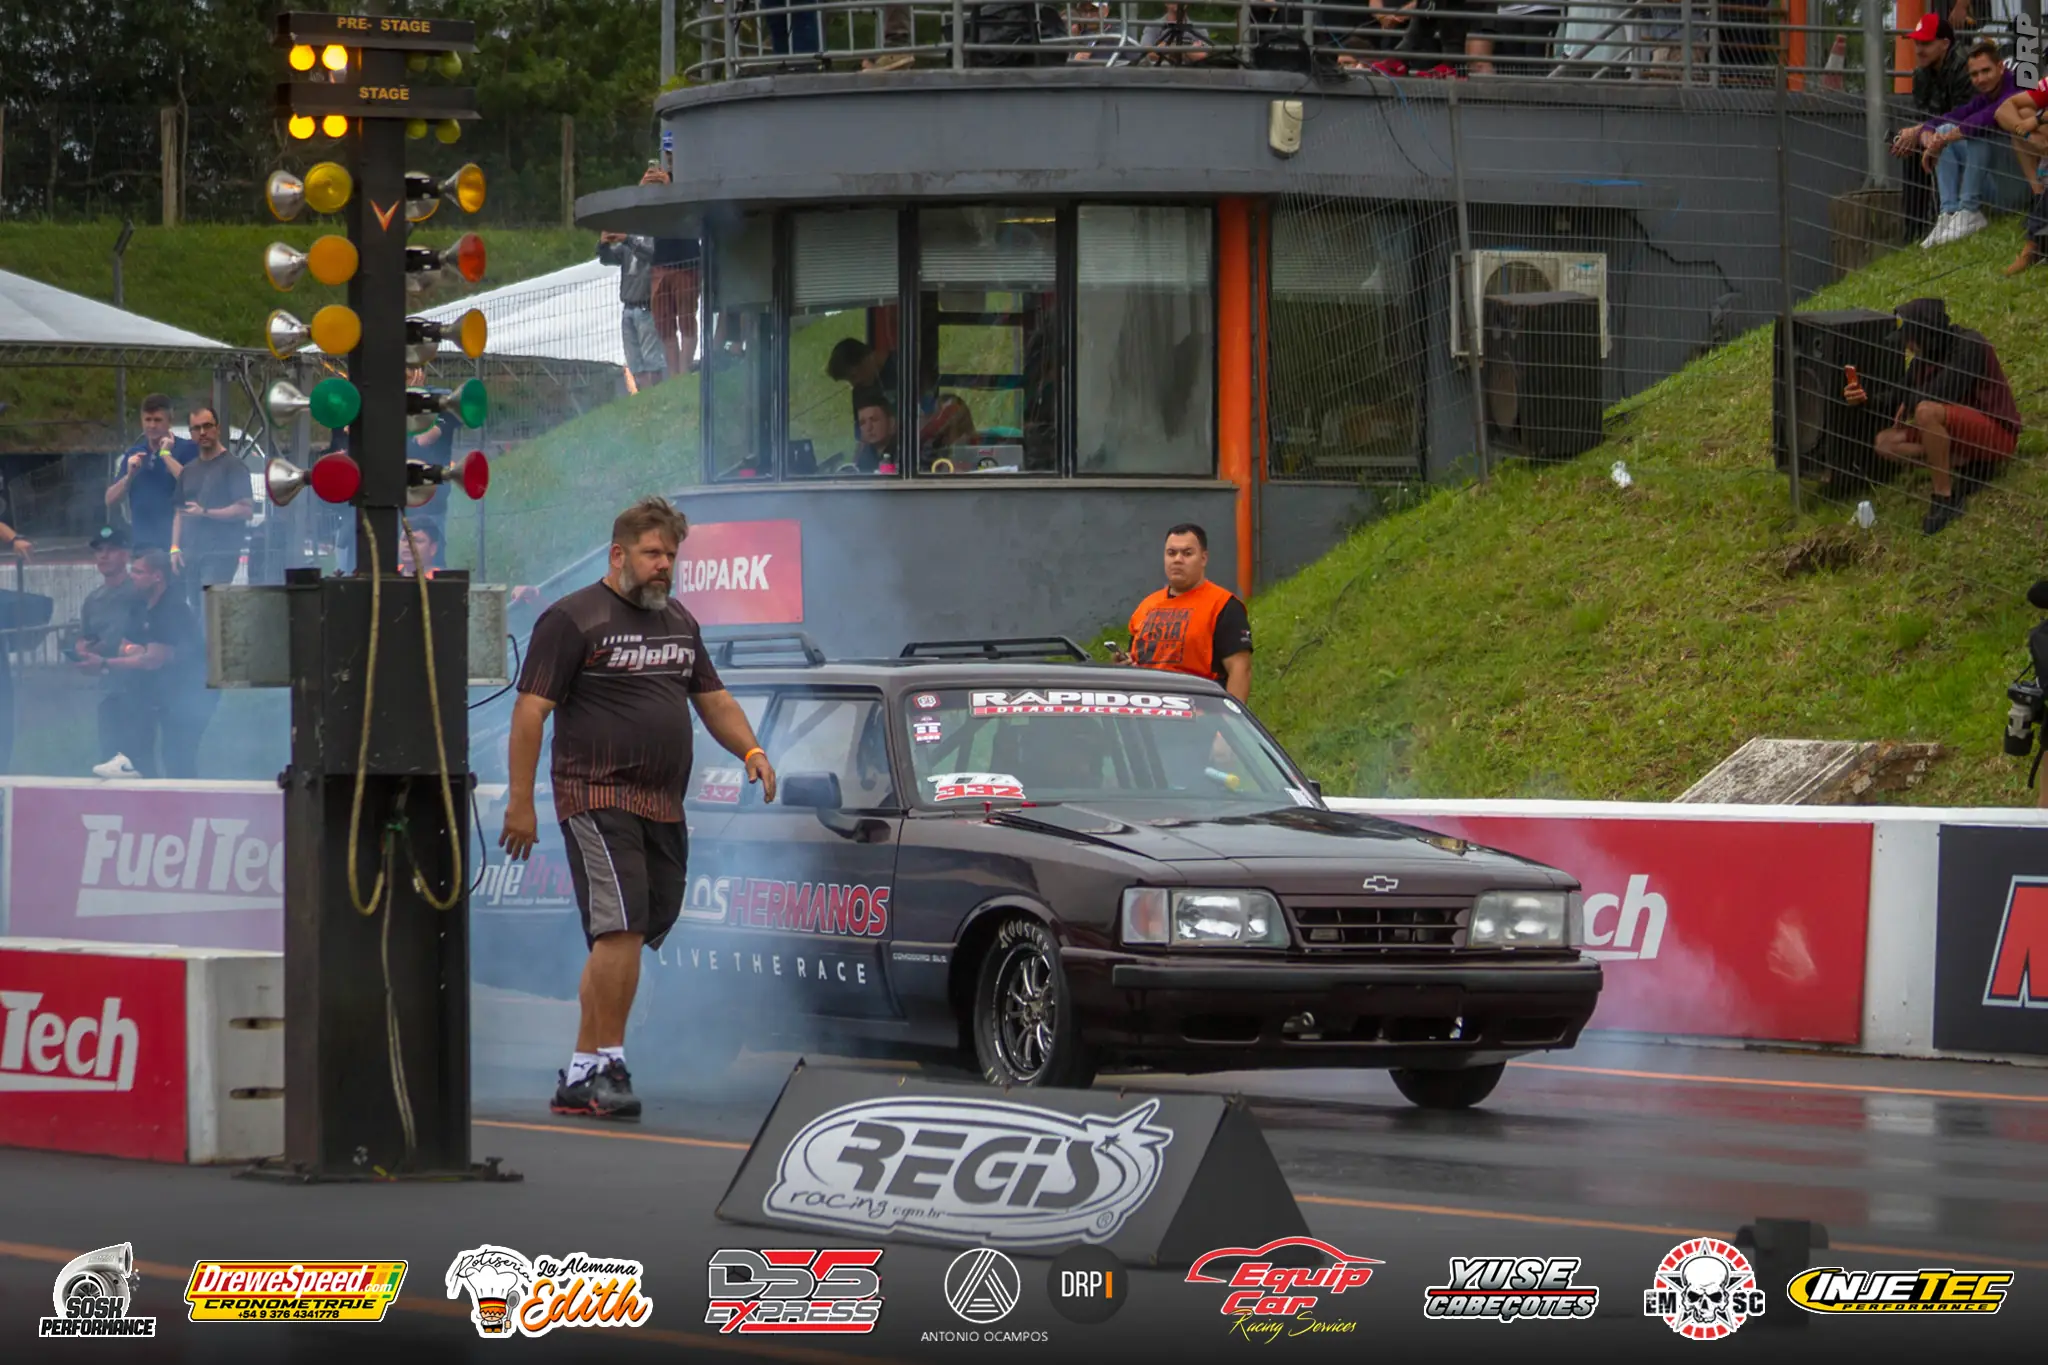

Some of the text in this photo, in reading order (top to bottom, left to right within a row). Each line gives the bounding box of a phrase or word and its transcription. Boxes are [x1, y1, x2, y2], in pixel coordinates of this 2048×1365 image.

[381, 20, 431, 33] STAGE
[359, 87, 409, 100] STAGE
[972, 692, 1191, 709] RAPIDOS
[935, 784, 1026, 801] 332
[659, 948, 867, 984] LIVE THE RACE
[789, 1190, 889, 1219] racing
